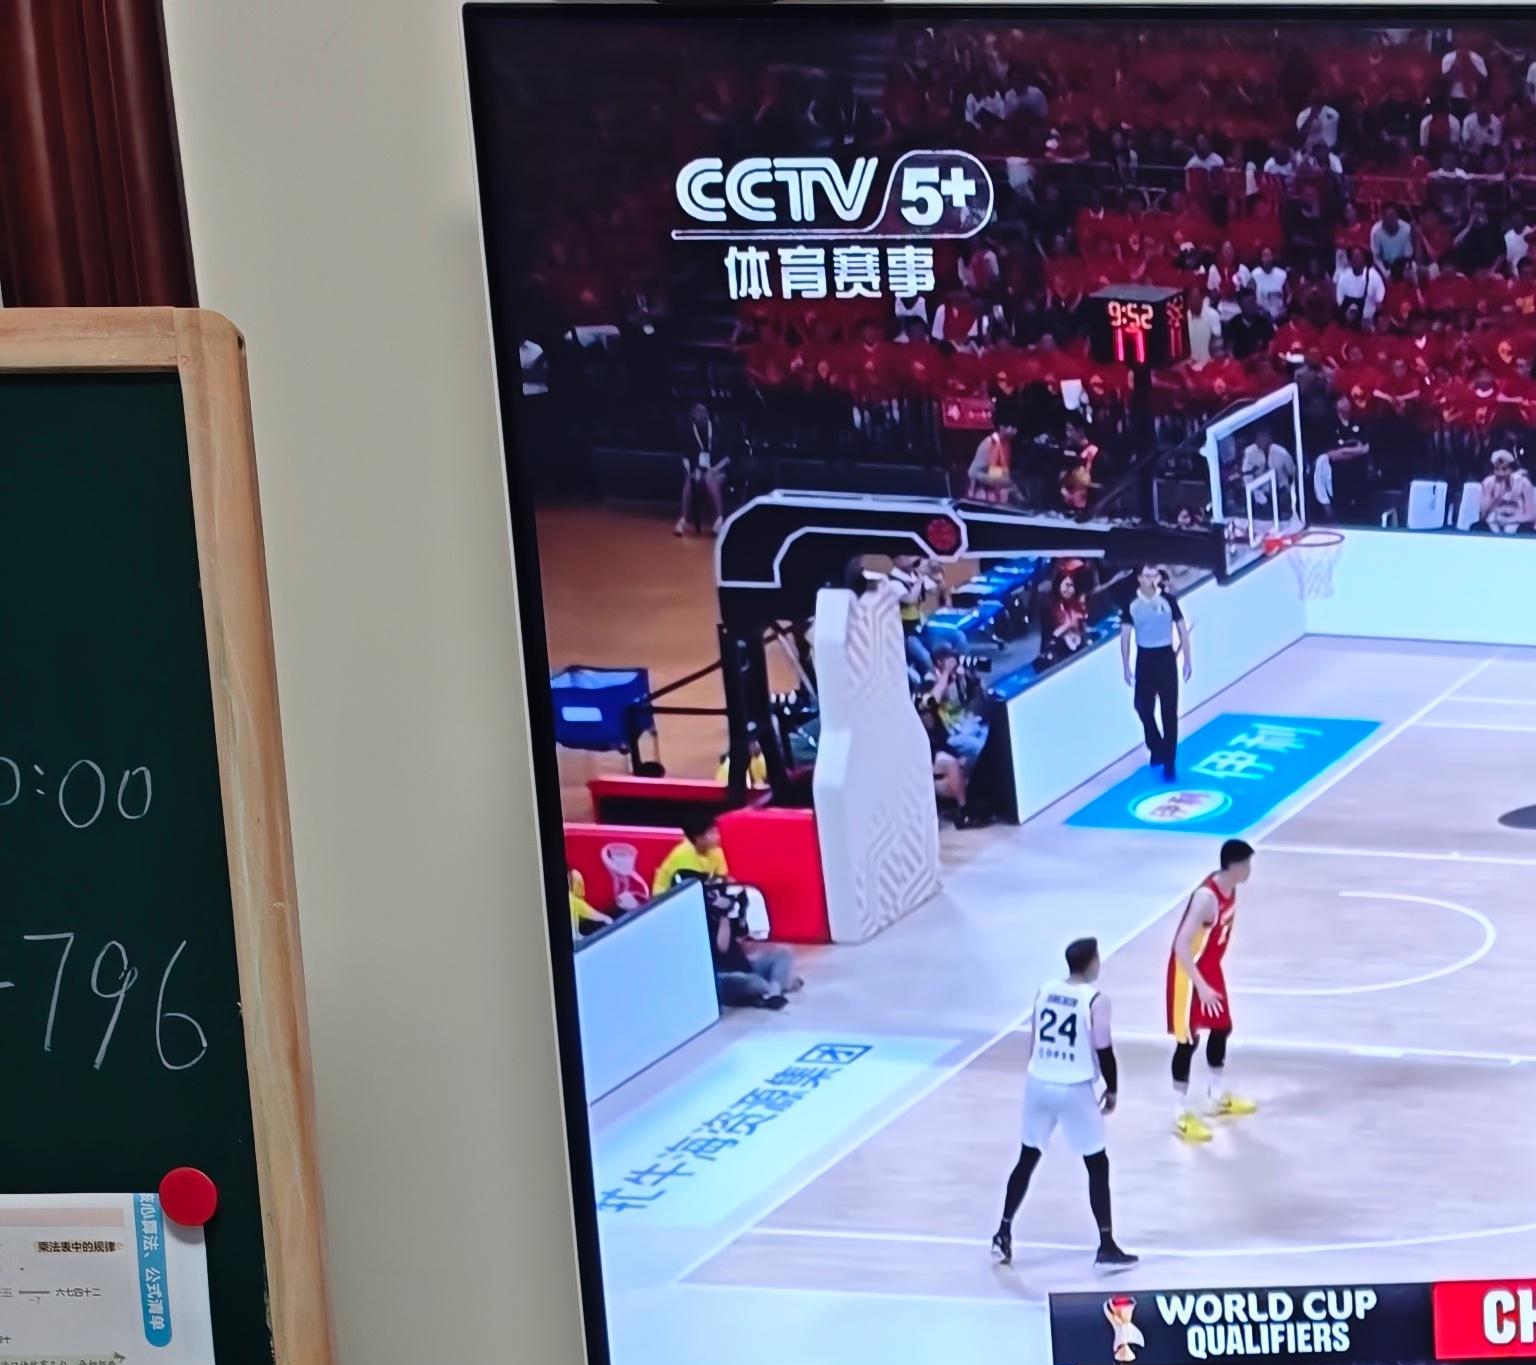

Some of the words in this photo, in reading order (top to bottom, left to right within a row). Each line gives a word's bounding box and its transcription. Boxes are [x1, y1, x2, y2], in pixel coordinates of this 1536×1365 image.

[675, 156, 879, 222] CCTV
[900, 166, 977, 227] 5+
[724, 245, 935, 300] 体育赛事
[1107, 300, 1154, 330] 9:52
[1040, 1008, 1077, 1047] 24
[56, 1288, 101, 1298] 六七四十二
[1157, 1291, 1298, 1323] WORLD
[1303, 1288, 1378, 1321] CUP
[1187, 1321, 1350, 1358] QUALIFIERS
